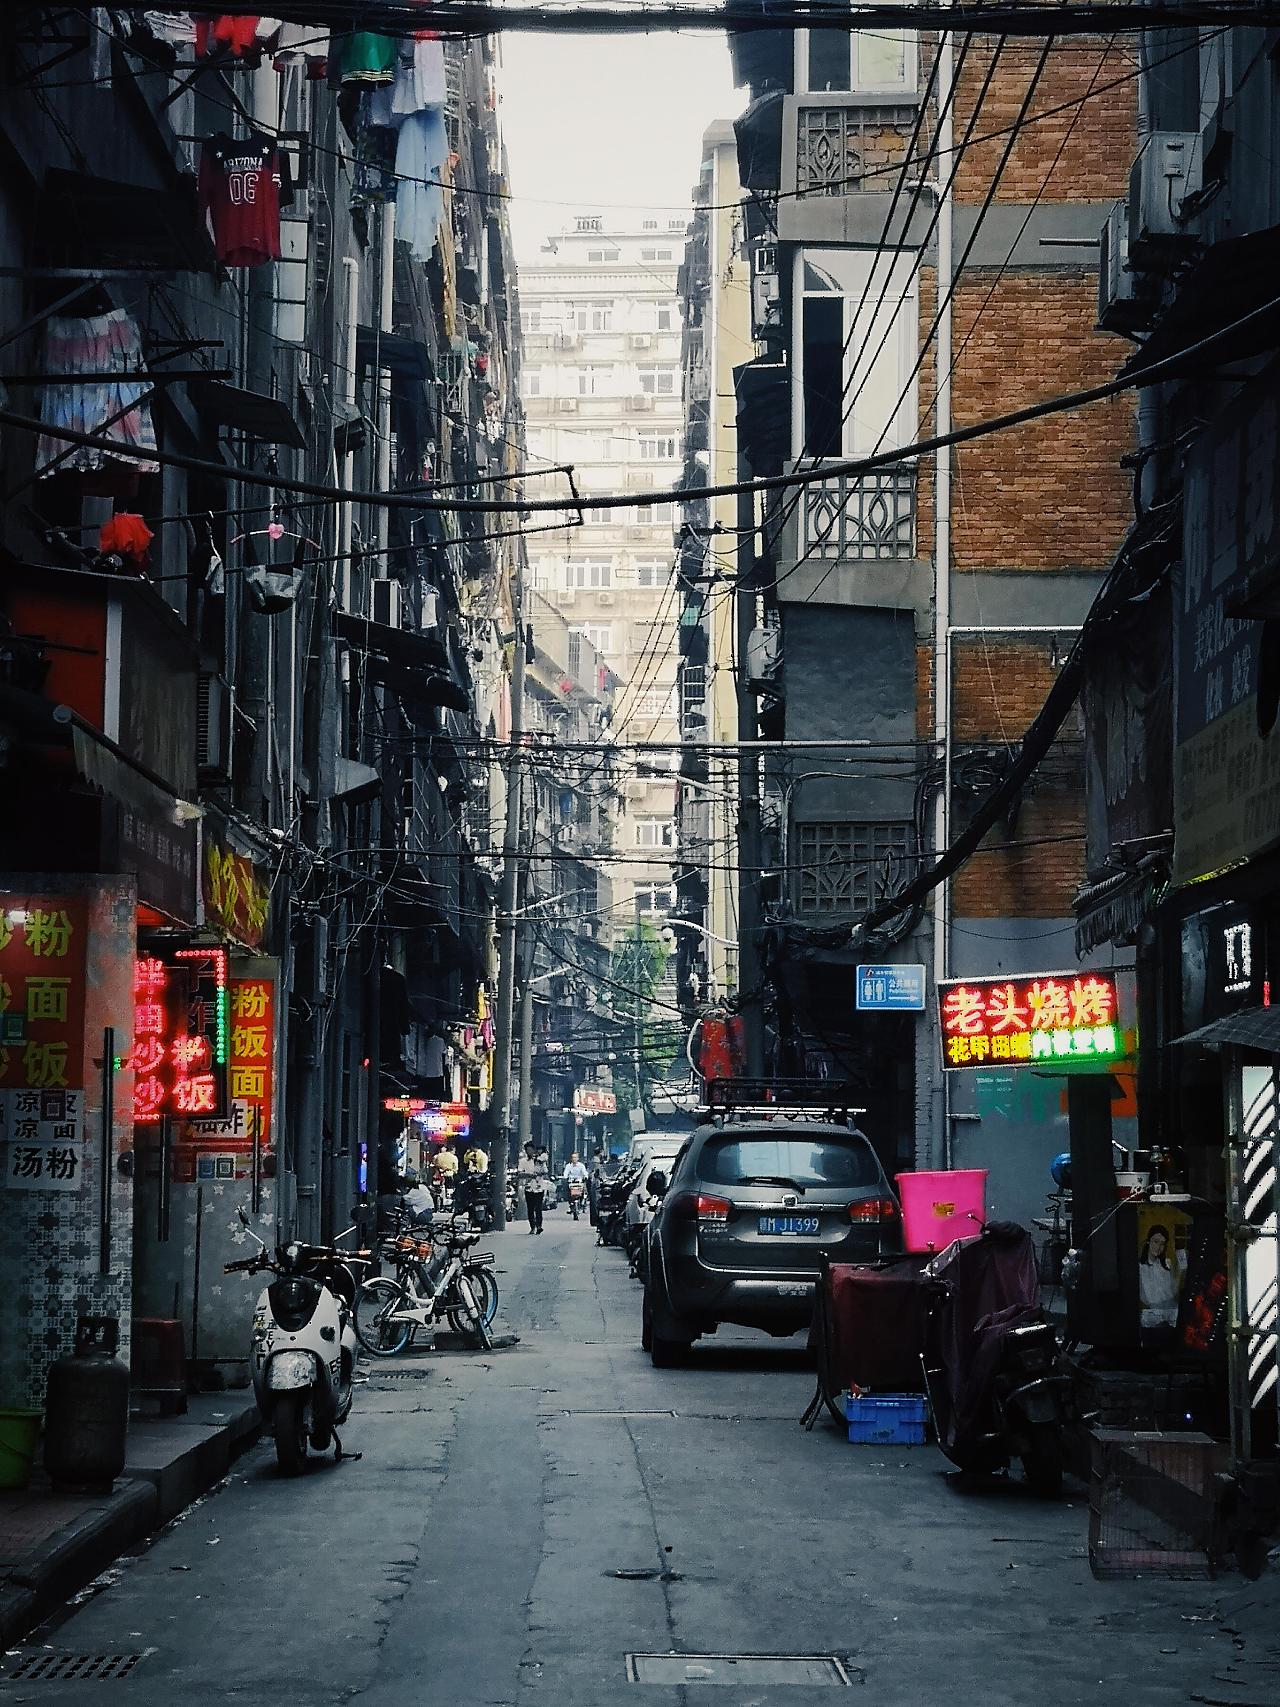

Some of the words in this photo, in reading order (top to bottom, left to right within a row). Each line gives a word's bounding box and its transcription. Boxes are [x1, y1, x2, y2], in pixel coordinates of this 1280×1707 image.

[223, 156, 263, 169] ARIZONA
[228, 172, 260, 205] 06
[943, 975, 1113, 1033] 老头烧烤
[13, 1147, 79, 1180] 汤粉
